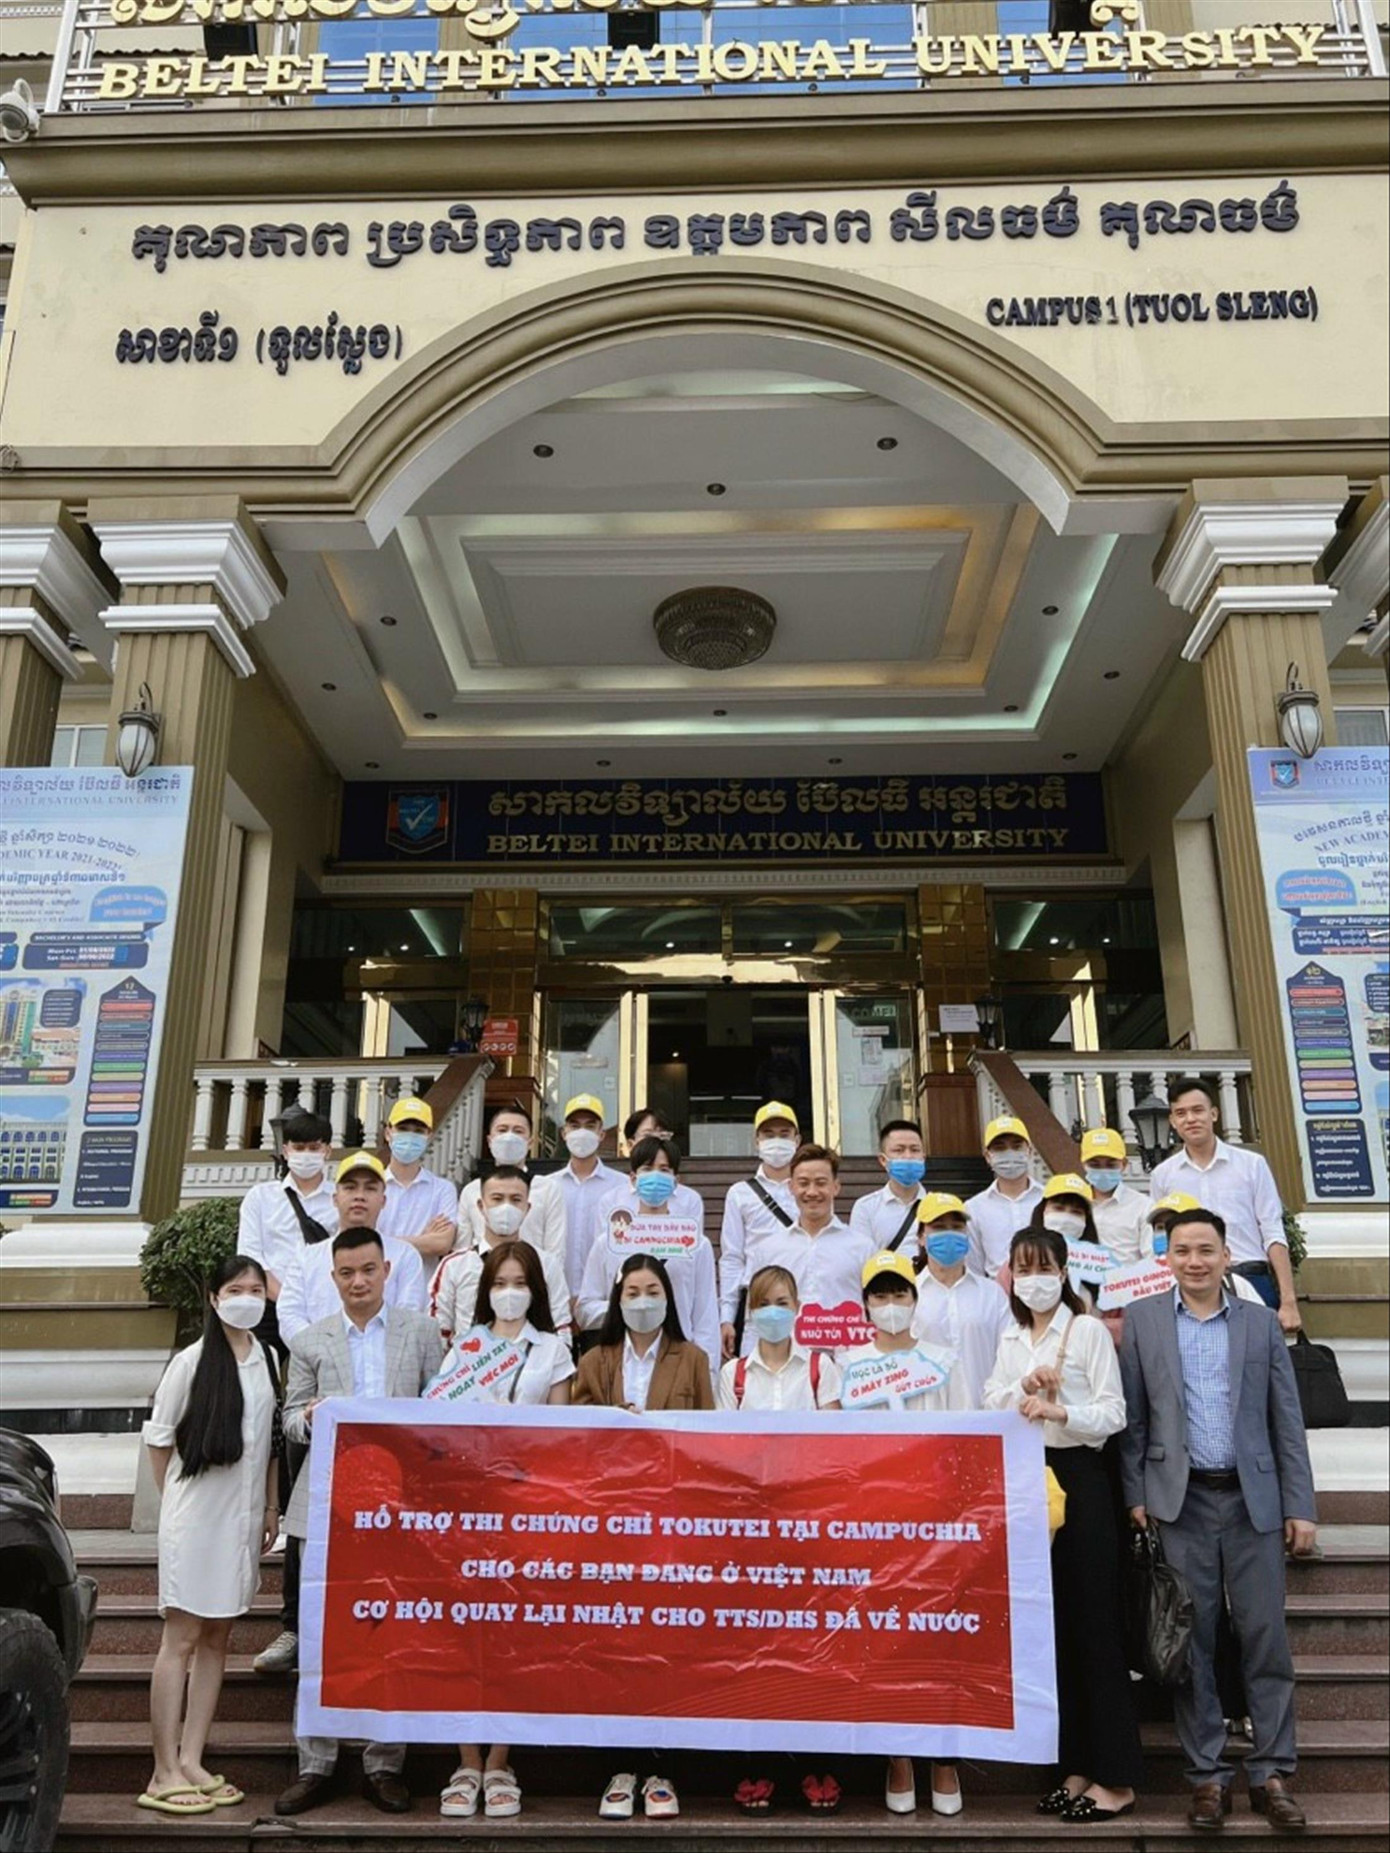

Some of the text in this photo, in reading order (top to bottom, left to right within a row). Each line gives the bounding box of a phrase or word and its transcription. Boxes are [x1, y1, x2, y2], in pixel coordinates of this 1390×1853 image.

[100, 26, 1326, 98] BELTEI INTERNATIONAL UNIVERSITY
[986, 296, 1100, 326] CAMPUS
[1124, 291, 1211, 327] (TUOL
[1215, 286, 1319, 322] SLENG)
[487, 828, 1069, 854] BELTEI INTERNATIONAL UNIVERSITY
[448, 1375, 476, 1400] NGAY
[354, 1504, 982, 1542] HỖ TRỢ THI CHỨNG CHỈ TOKUTEI TẠI CAMPUCHIA
[461, 1560, 515, 1579] CHO
[522, 1558, 574, 1580] CÁC
[581, 1562, 634, 1584] BẠN
[641, 1563, 713, 1583] ĐANG
[746, 1563, 806, 1588] VIỆT
[812, 1568, 872, 1586] NAM
[353, 1599, 390, 1619] CƠ
[395, 1597, 443, 1623] HỘI
[450, 1601, 518, 1625] QUAY
[524, 1603, 567, 1627] LẠI
[573, 1602, 644, 1629] NHẬT
[651, 1606, 707, 1627] CHO
[867, 1605, 902, 1631] VỀ
[908, 1610, 981, 1634] NƯỚC
